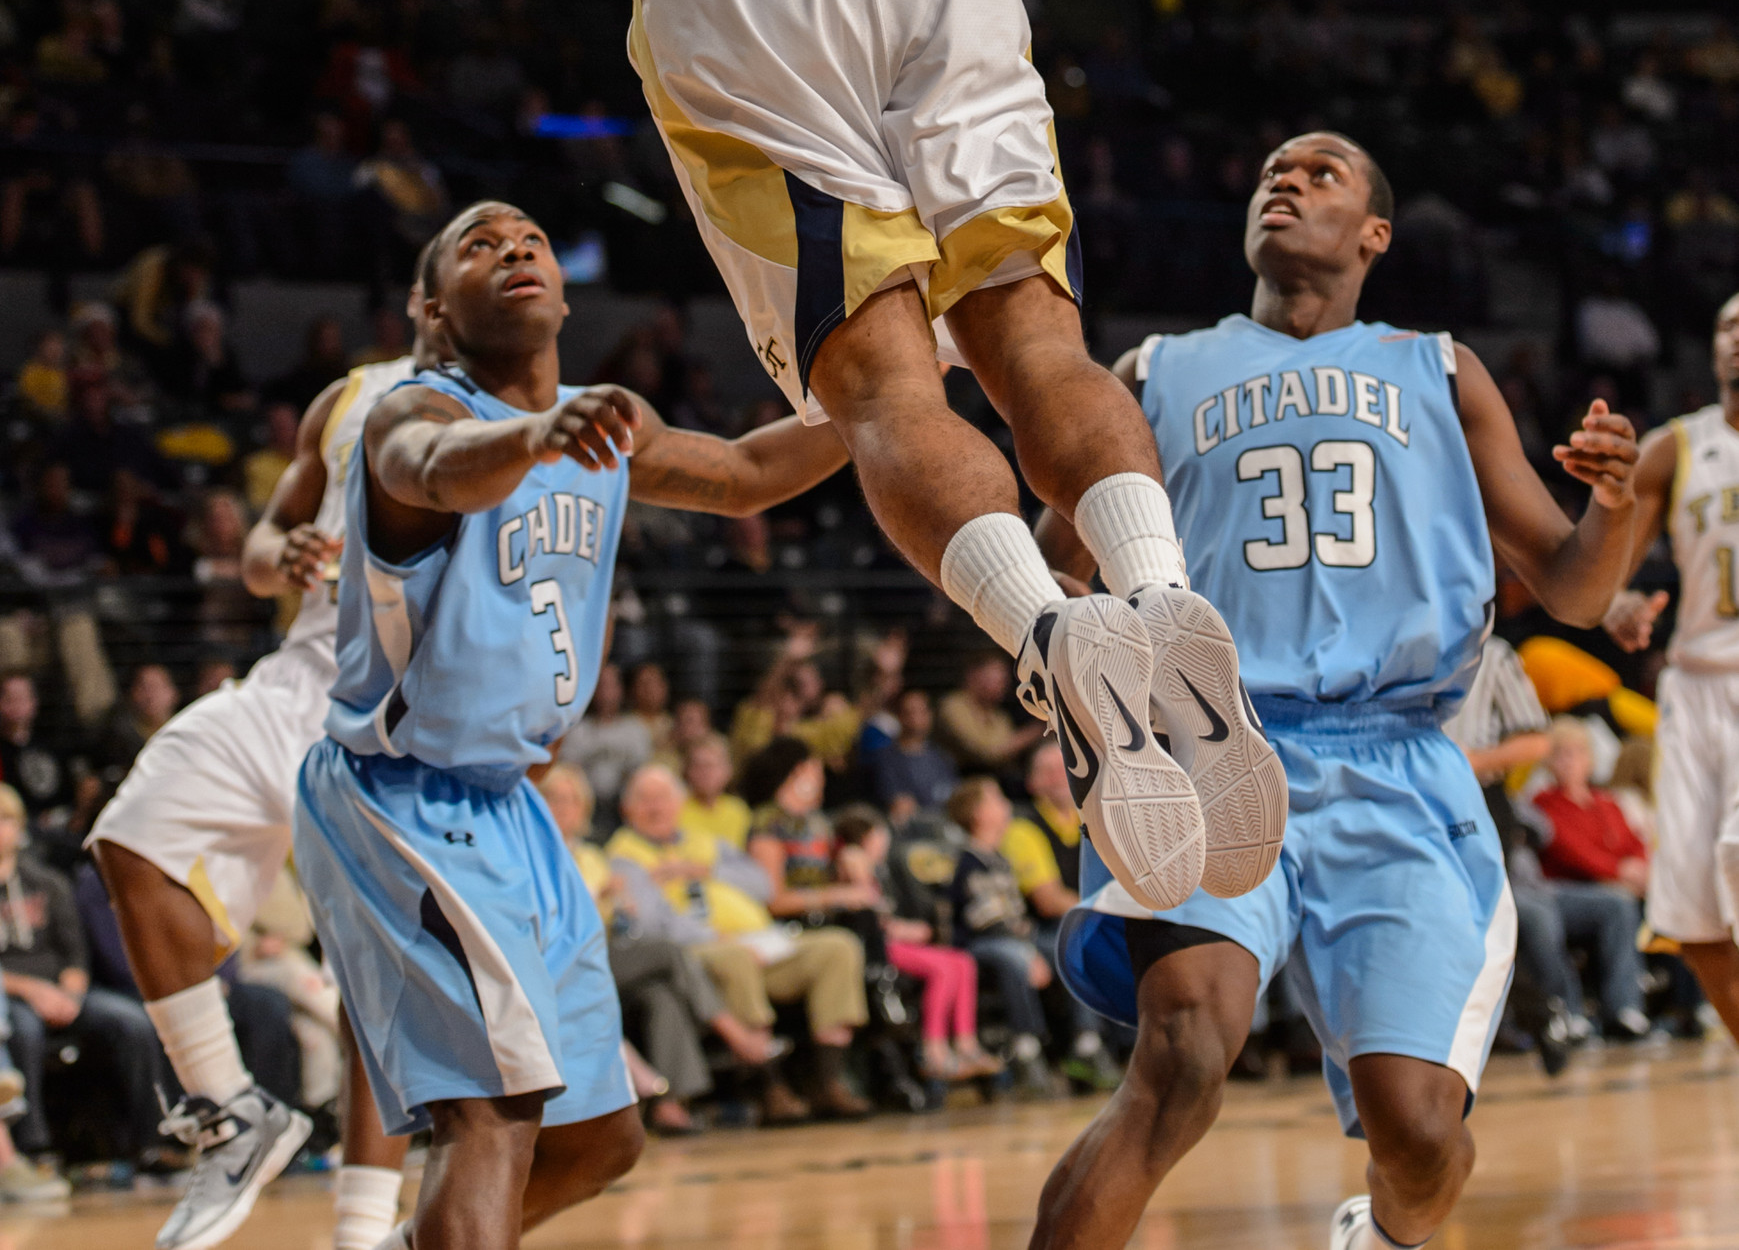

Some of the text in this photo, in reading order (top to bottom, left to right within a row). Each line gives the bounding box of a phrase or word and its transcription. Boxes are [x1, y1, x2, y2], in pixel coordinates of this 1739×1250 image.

[1193, 365, 1410, 457] CITADEL
[1236, 439, 1377, 572] 33
[530, 577, 580, 707] 3
